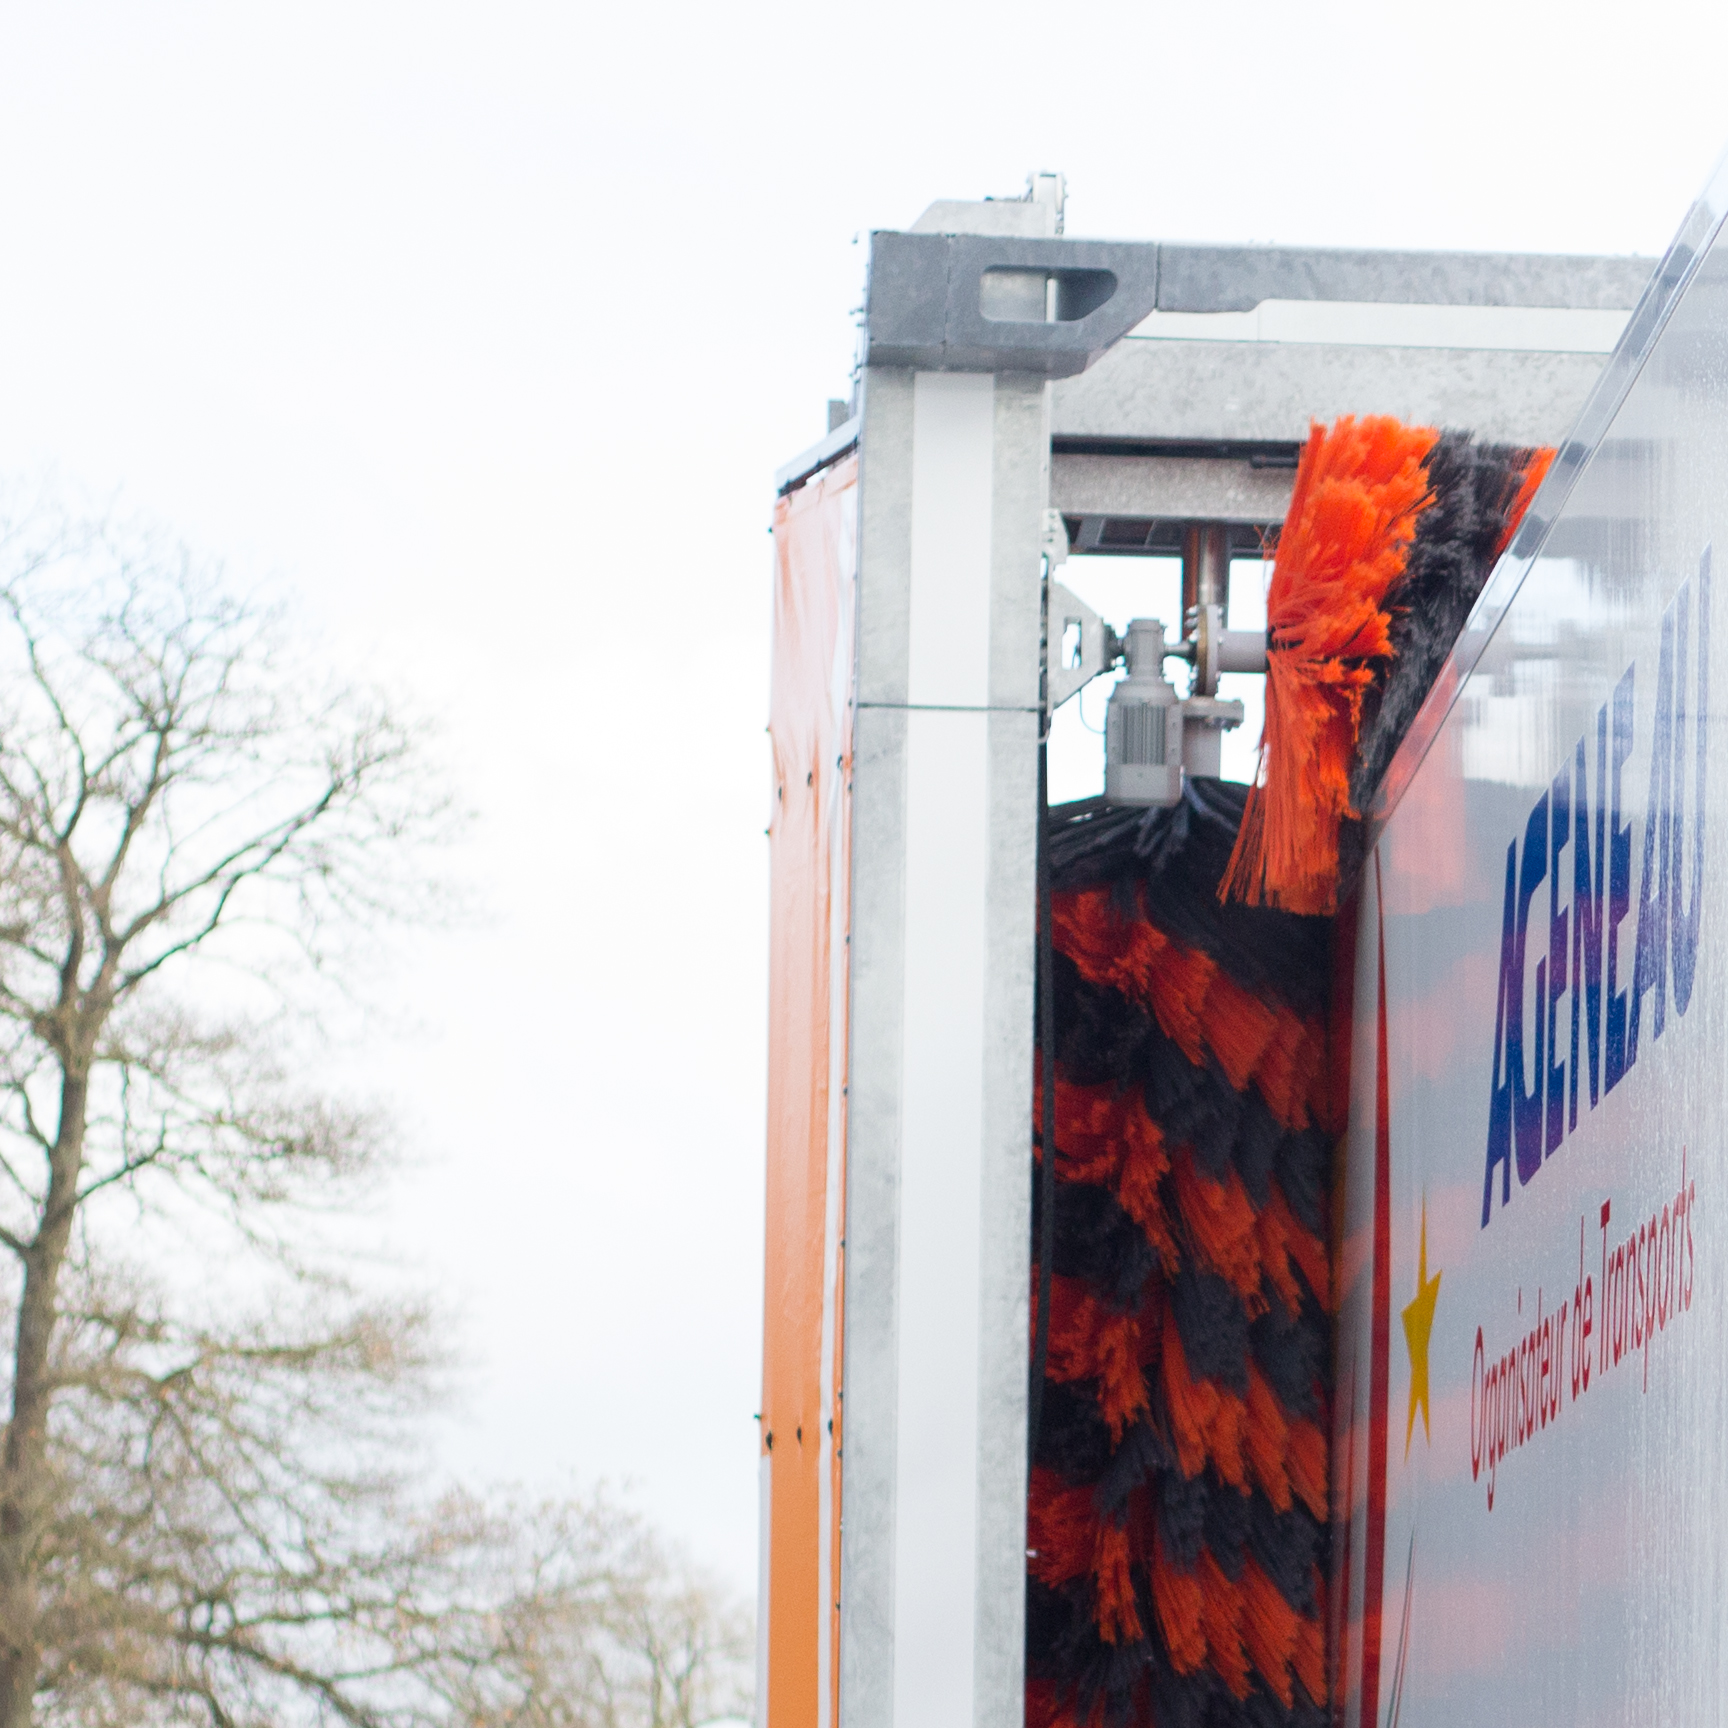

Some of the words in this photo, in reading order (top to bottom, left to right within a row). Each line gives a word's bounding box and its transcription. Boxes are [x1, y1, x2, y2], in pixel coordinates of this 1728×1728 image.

[1479, 538, 1713, 1231] AGENEAU
[1470, 1286, 1567, 1513] Organisateur
[1571, 1214, 1593, 1402] de
[1600, 1144, 1696, 1394] Transports
